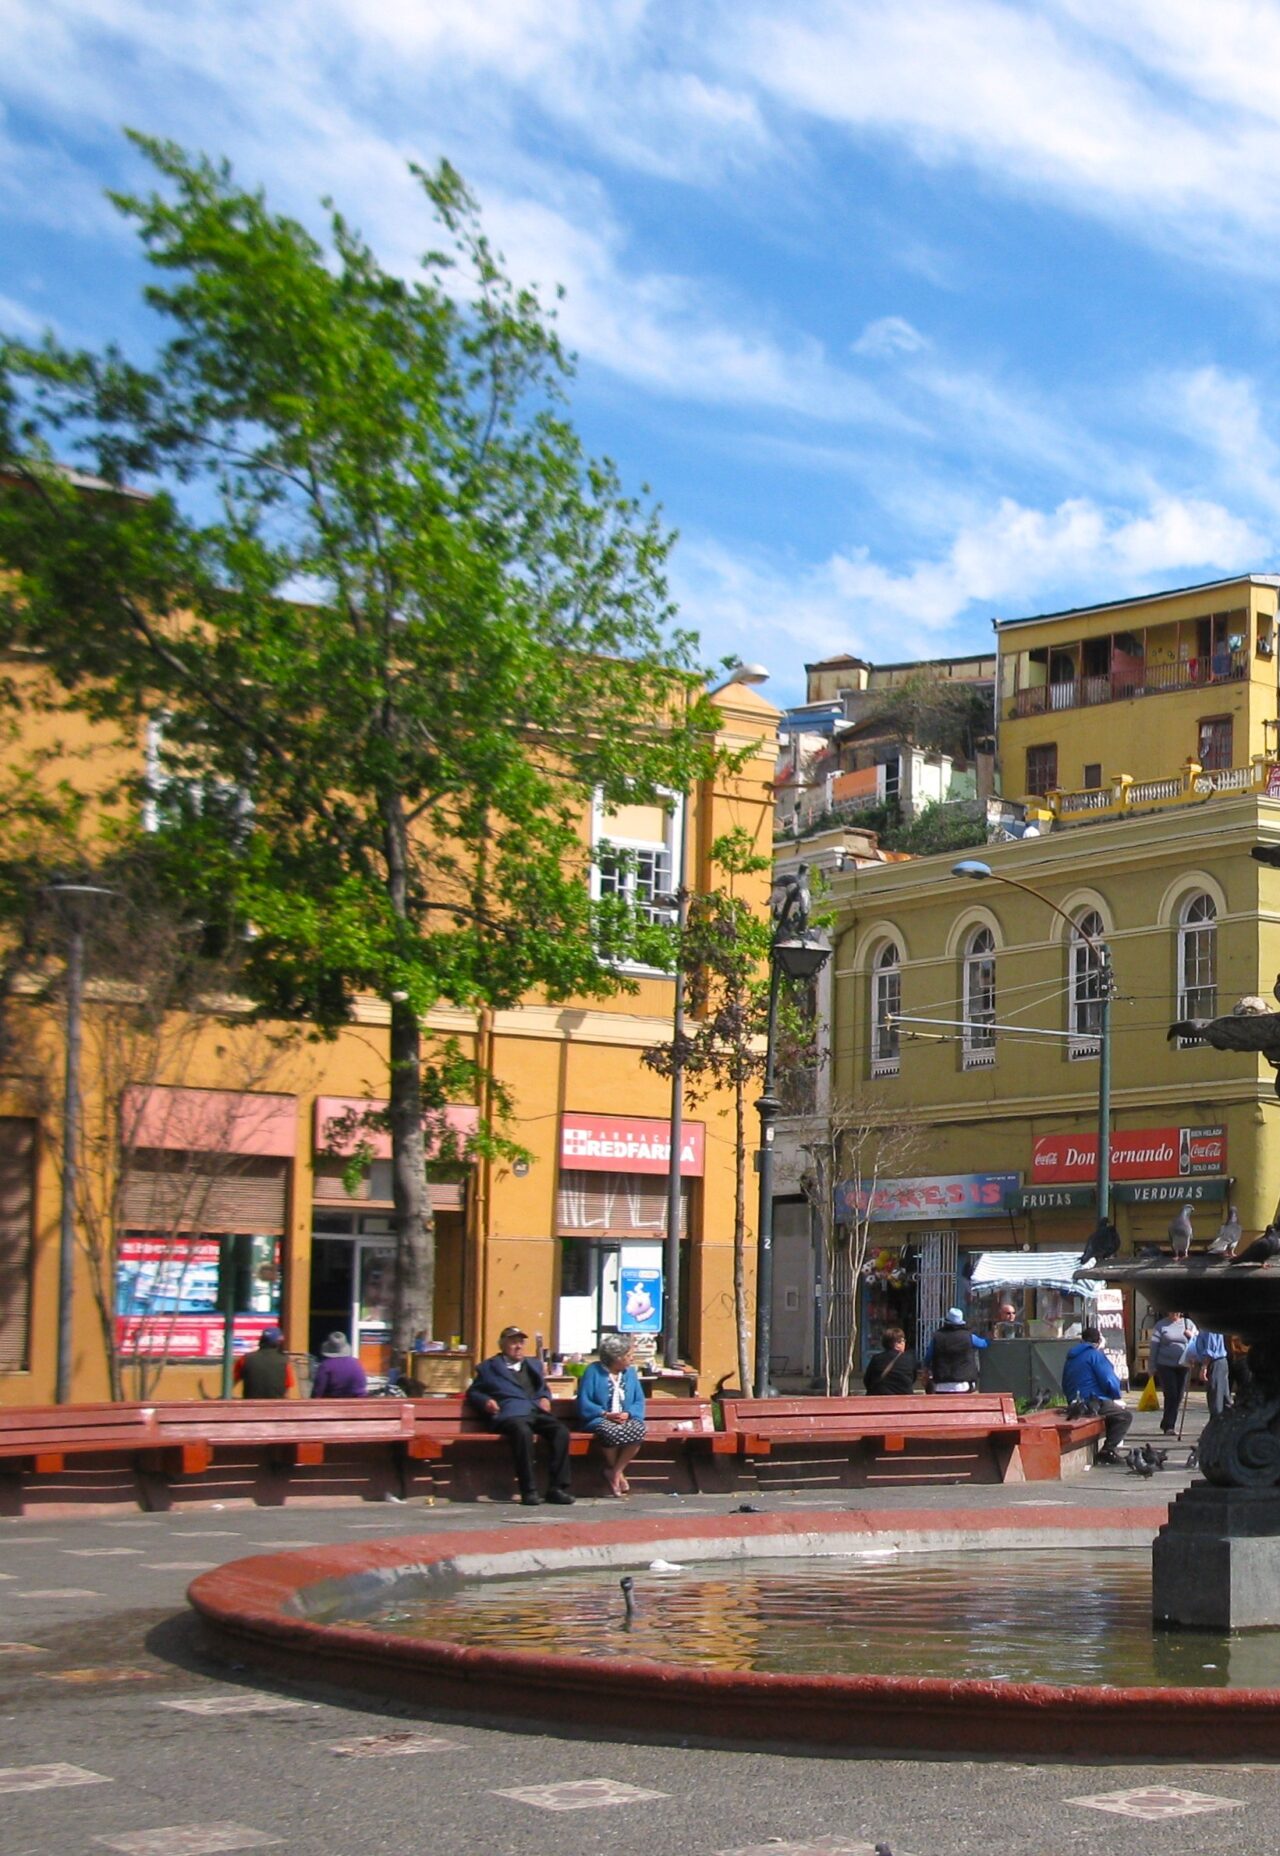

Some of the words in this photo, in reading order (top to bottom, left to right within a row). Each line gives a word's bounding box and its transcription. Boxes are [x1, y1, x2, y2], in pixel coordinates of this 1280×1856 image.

[587, 1130, 695, 1145] FARMACIS
[1065, 1148, 1096, 1166] Don
[1107, 1143, 1173, 1164] ernando
[1022, 1193, 1072, 1207] FRUTAS
[1134, 1186, 1203, 1200] VERDURAS
[764, 1238, 771, 1249] 2
